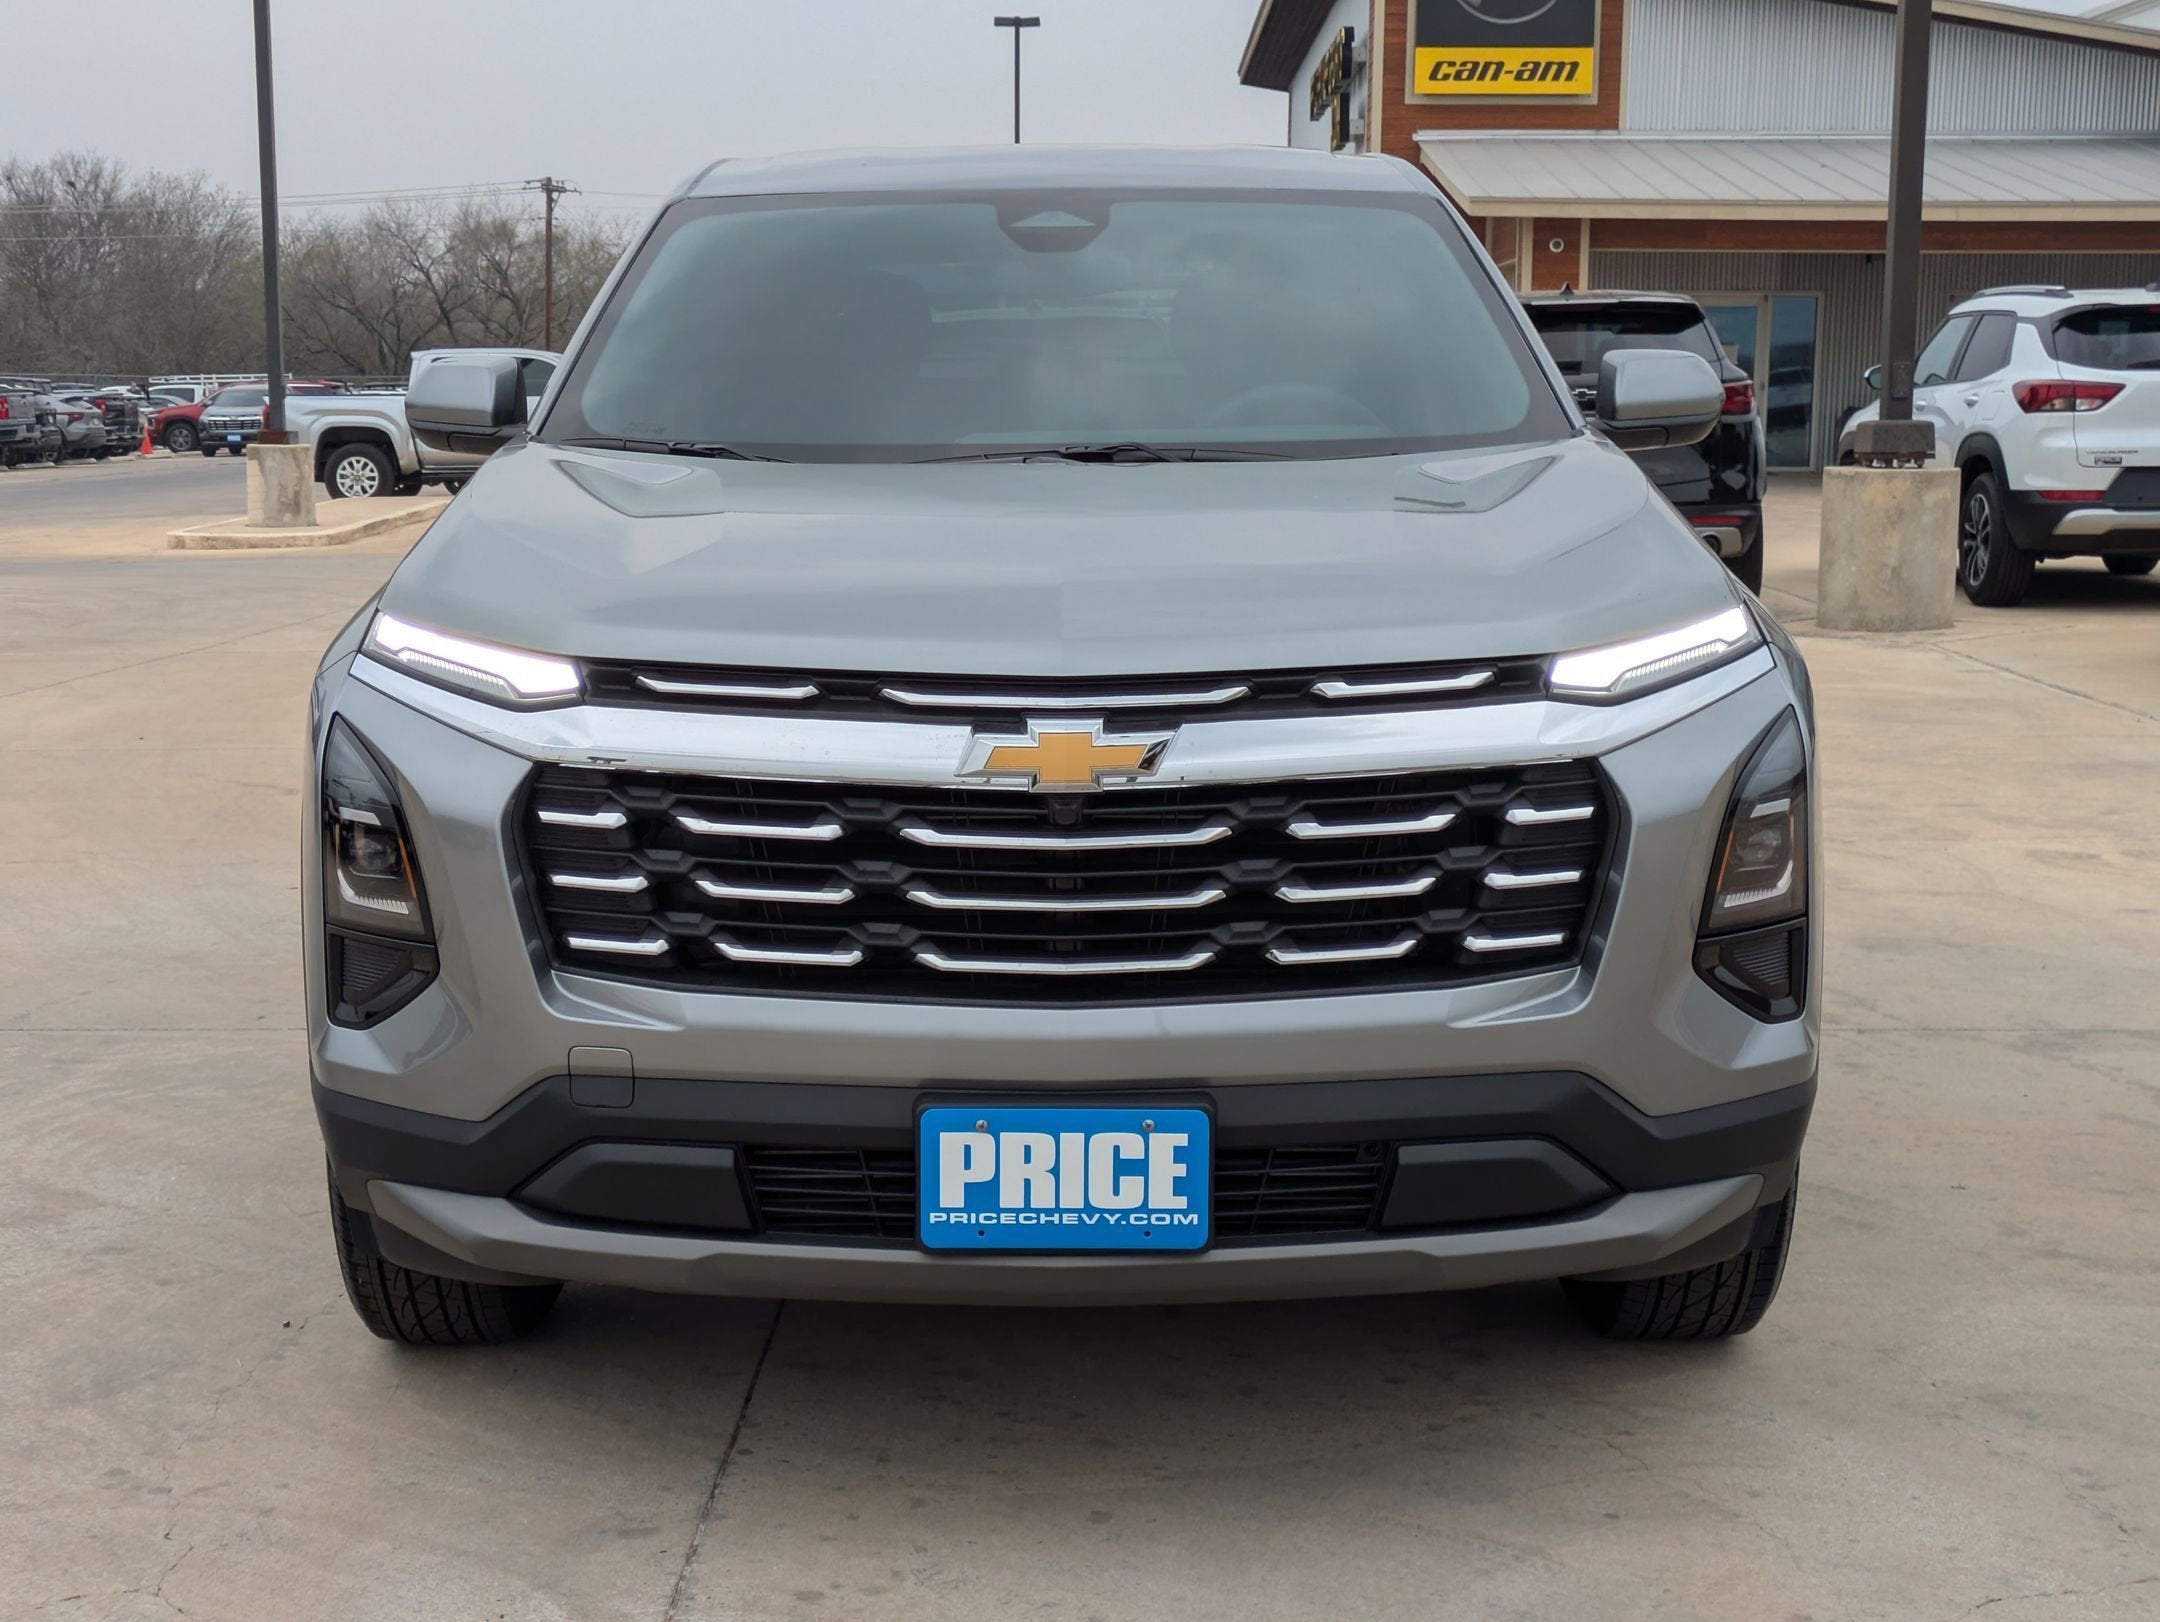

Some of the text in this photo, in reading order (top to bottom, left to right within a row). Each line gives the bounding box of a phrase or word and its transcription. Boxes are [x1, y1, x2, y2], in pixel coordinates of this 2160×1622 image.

[1428, 60, 1580, 82] can-am
[939, 1131, 1189, 1210] PRICE
[929, 1212, 1199, 1226] PRICECHEVY.COM
